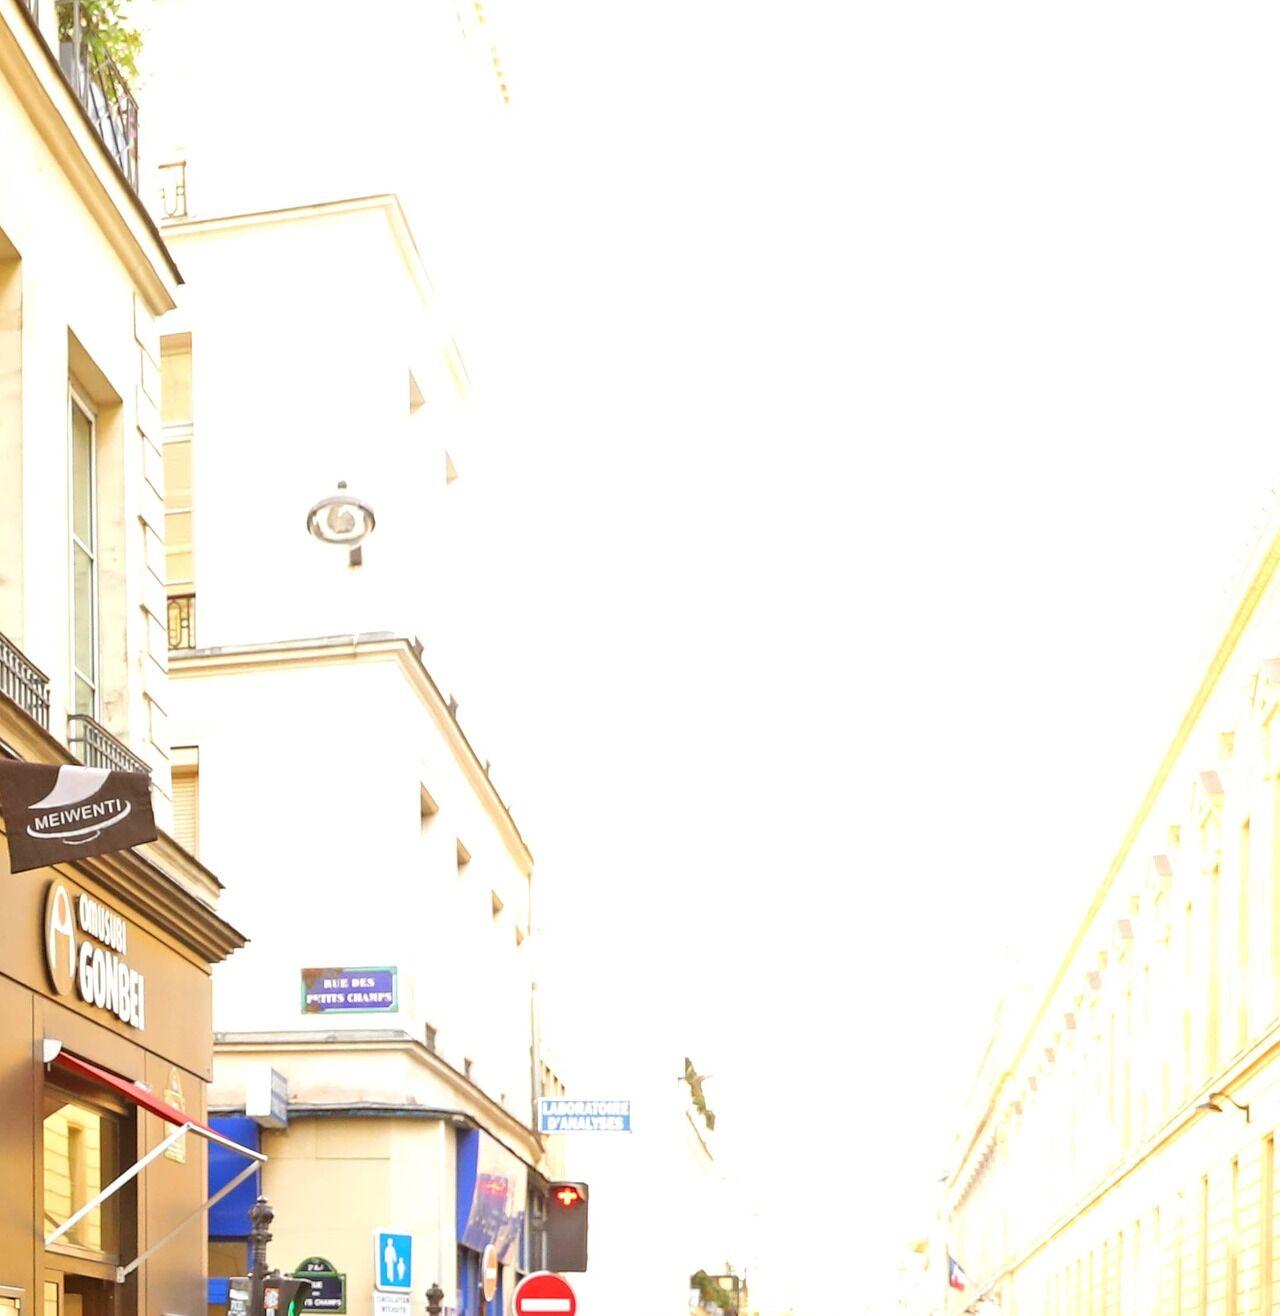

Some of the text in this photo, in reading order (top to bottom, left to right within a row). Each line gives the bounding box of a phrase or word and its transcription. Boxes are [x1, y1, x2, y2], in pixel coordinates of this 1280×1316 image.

[34, 799, 122, 830] MEIWENTI
[79, 893, 127, 955] OMUSUBI
[79, 941, 145, 1031] GONBEI
[323, 977, 376, 989] RUE DES
[346, 992, 393, 1003] CHAMPS
[542, 1100, 628, 1115] LABORATOIRE
[547, 1116, 624, 1130] D'ANALYSES
